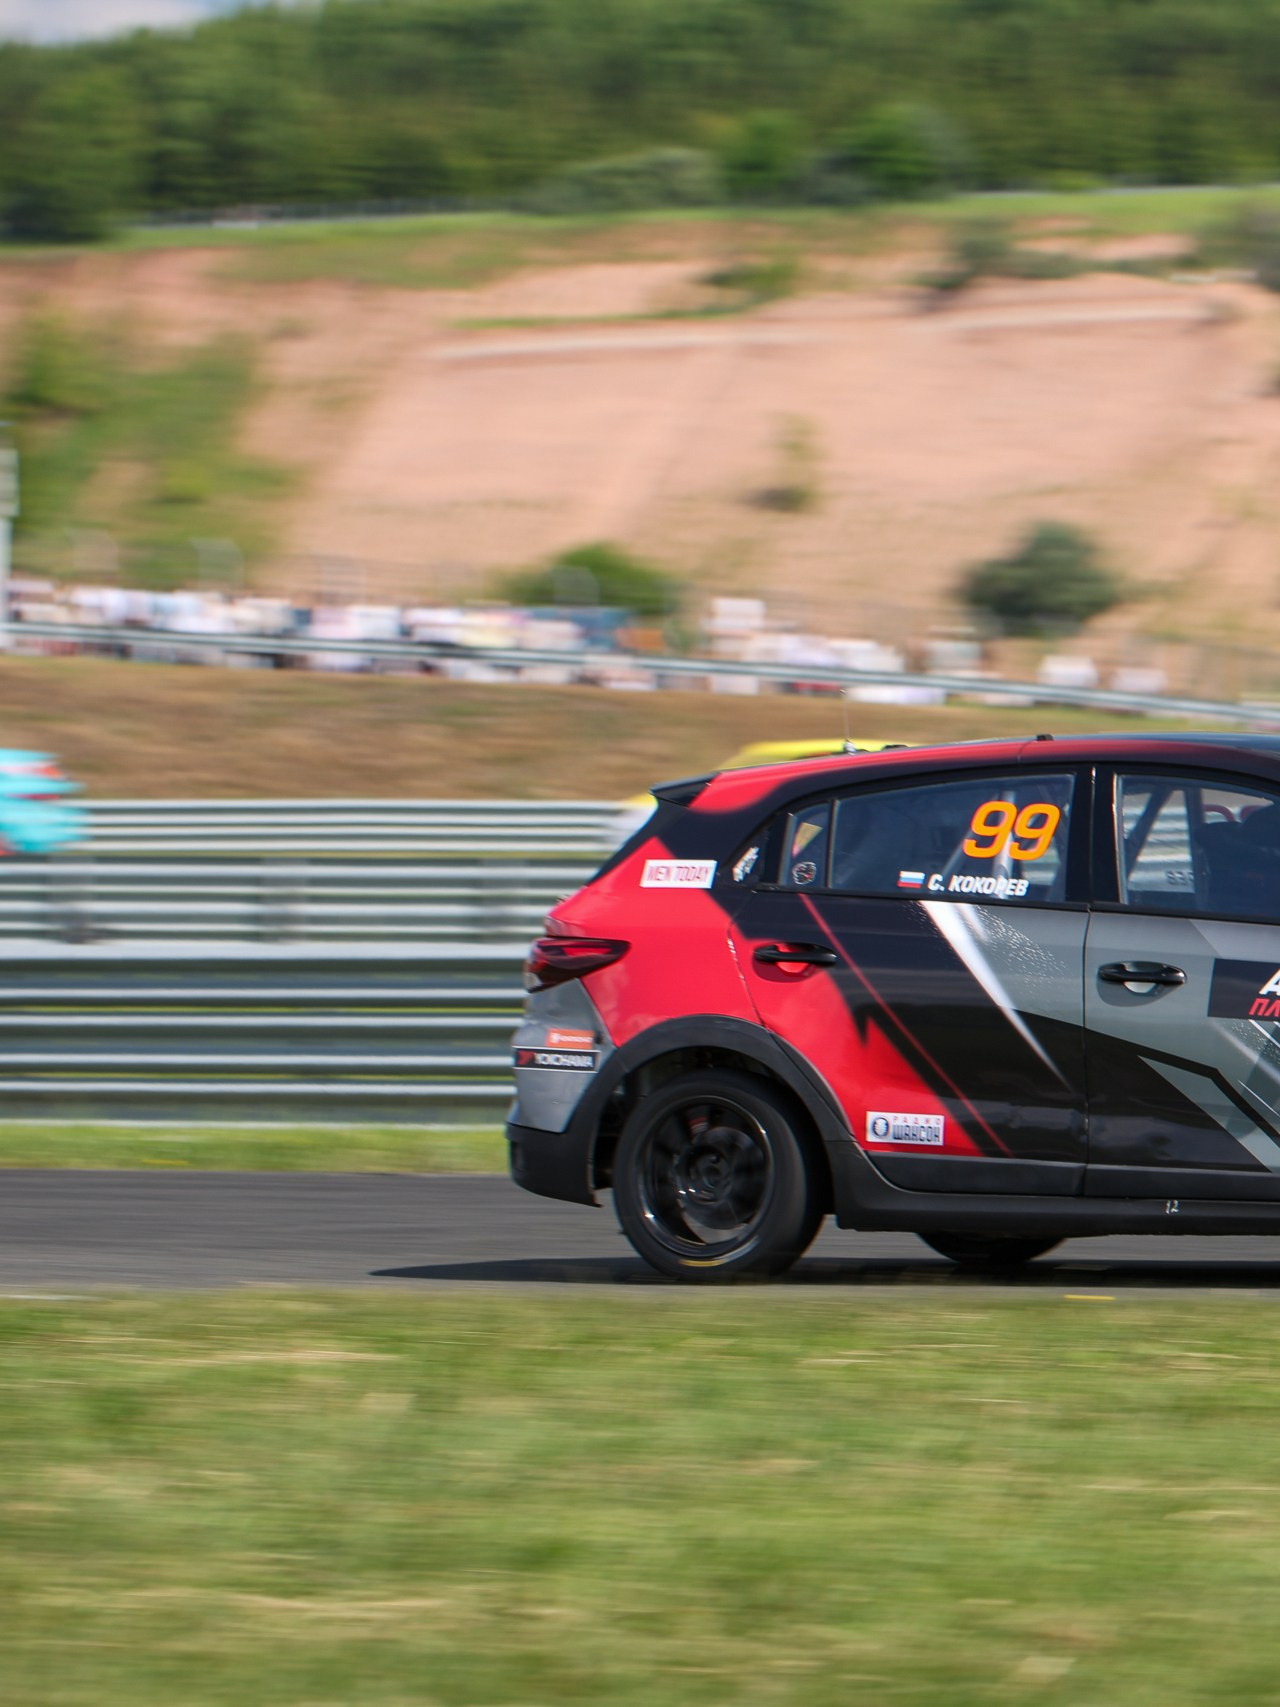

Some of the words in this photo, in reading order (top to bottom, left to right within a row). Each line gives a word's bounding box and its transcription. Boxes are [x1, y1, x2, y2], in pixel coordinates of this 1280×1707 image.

[962, 800, 1061, 861] 99
[647, 866, 671, 881] MEN
[676, 866, 711, 882] TODAY
[948, 875, 1029, 897] КОКОРЕВ
